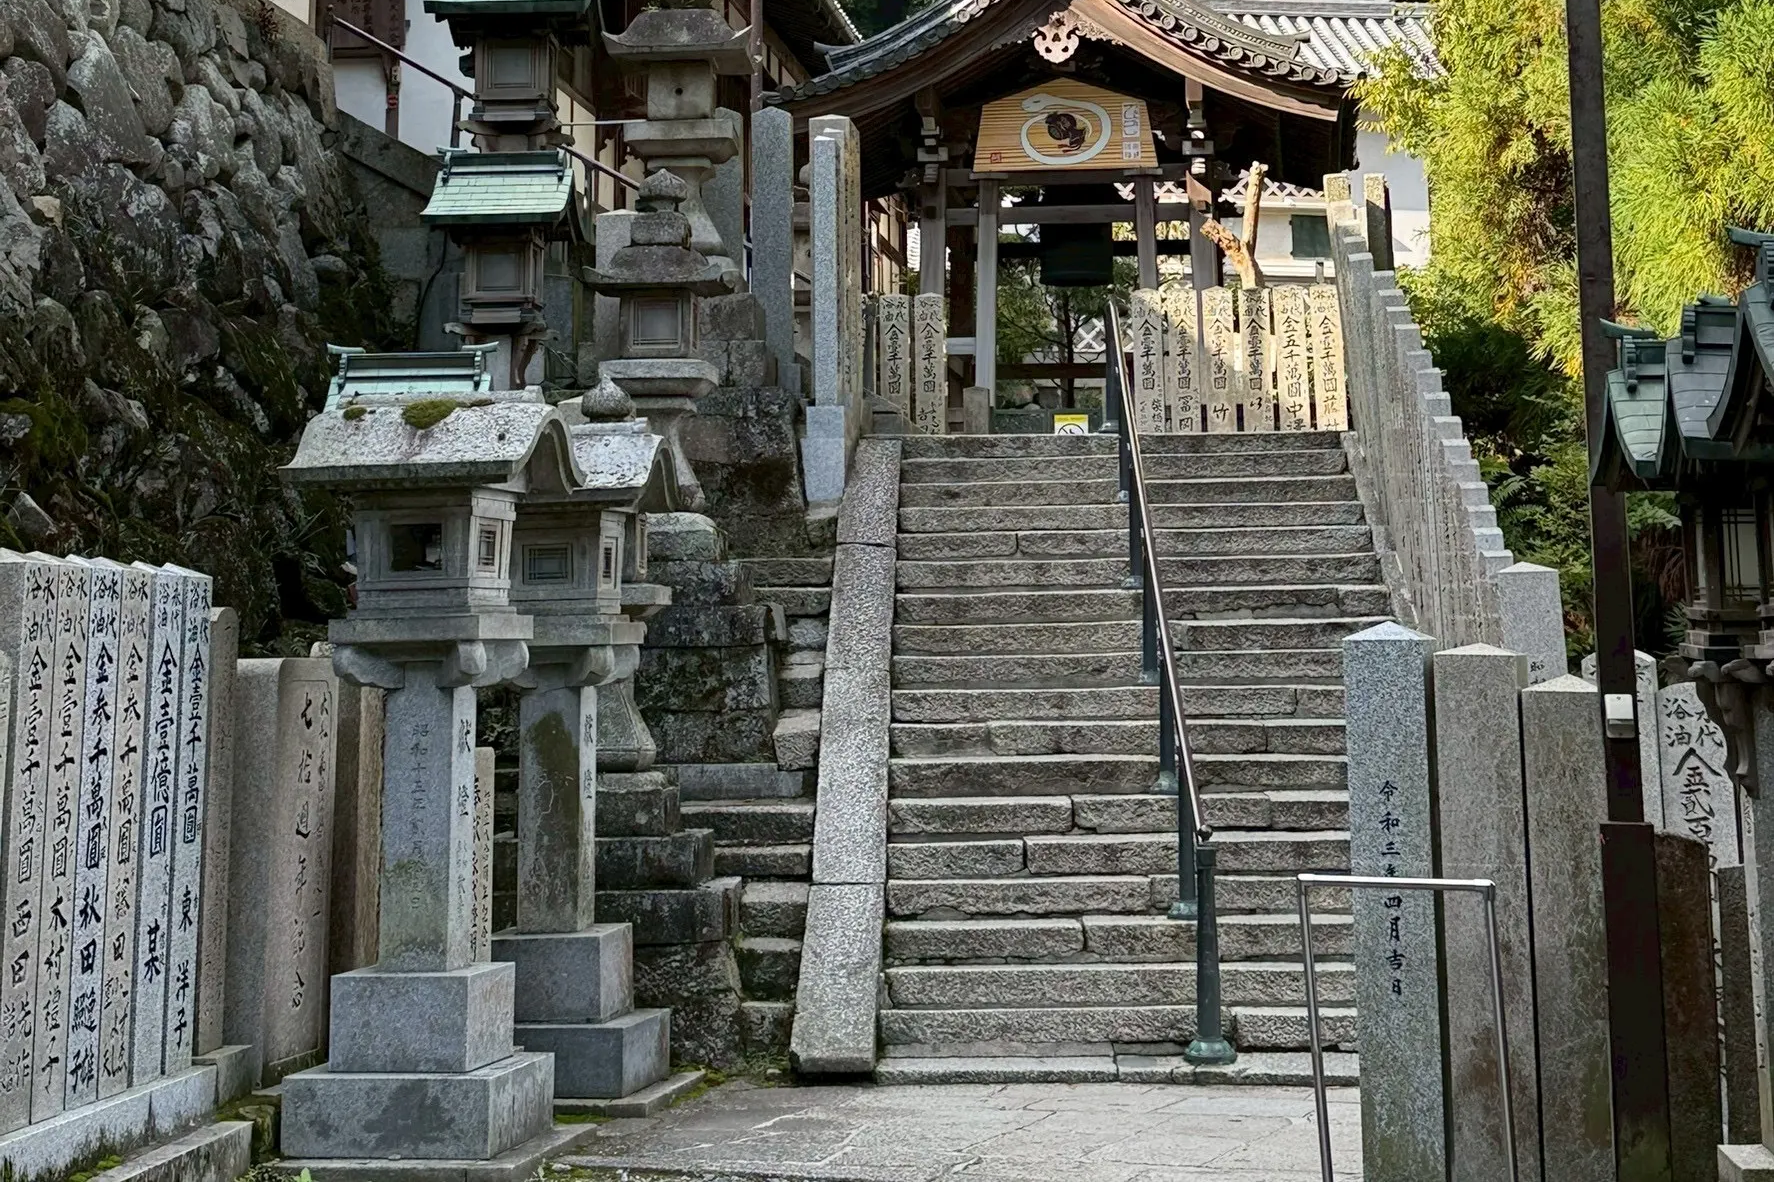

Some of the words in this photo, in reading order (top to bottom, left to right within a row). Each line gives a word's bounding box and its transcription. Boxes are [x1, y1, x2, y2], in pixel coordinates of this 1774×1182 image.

[1663, 698, 1692, 747] 浴油
[1379, 779, 1405, 996] 令和三年四月吉日
